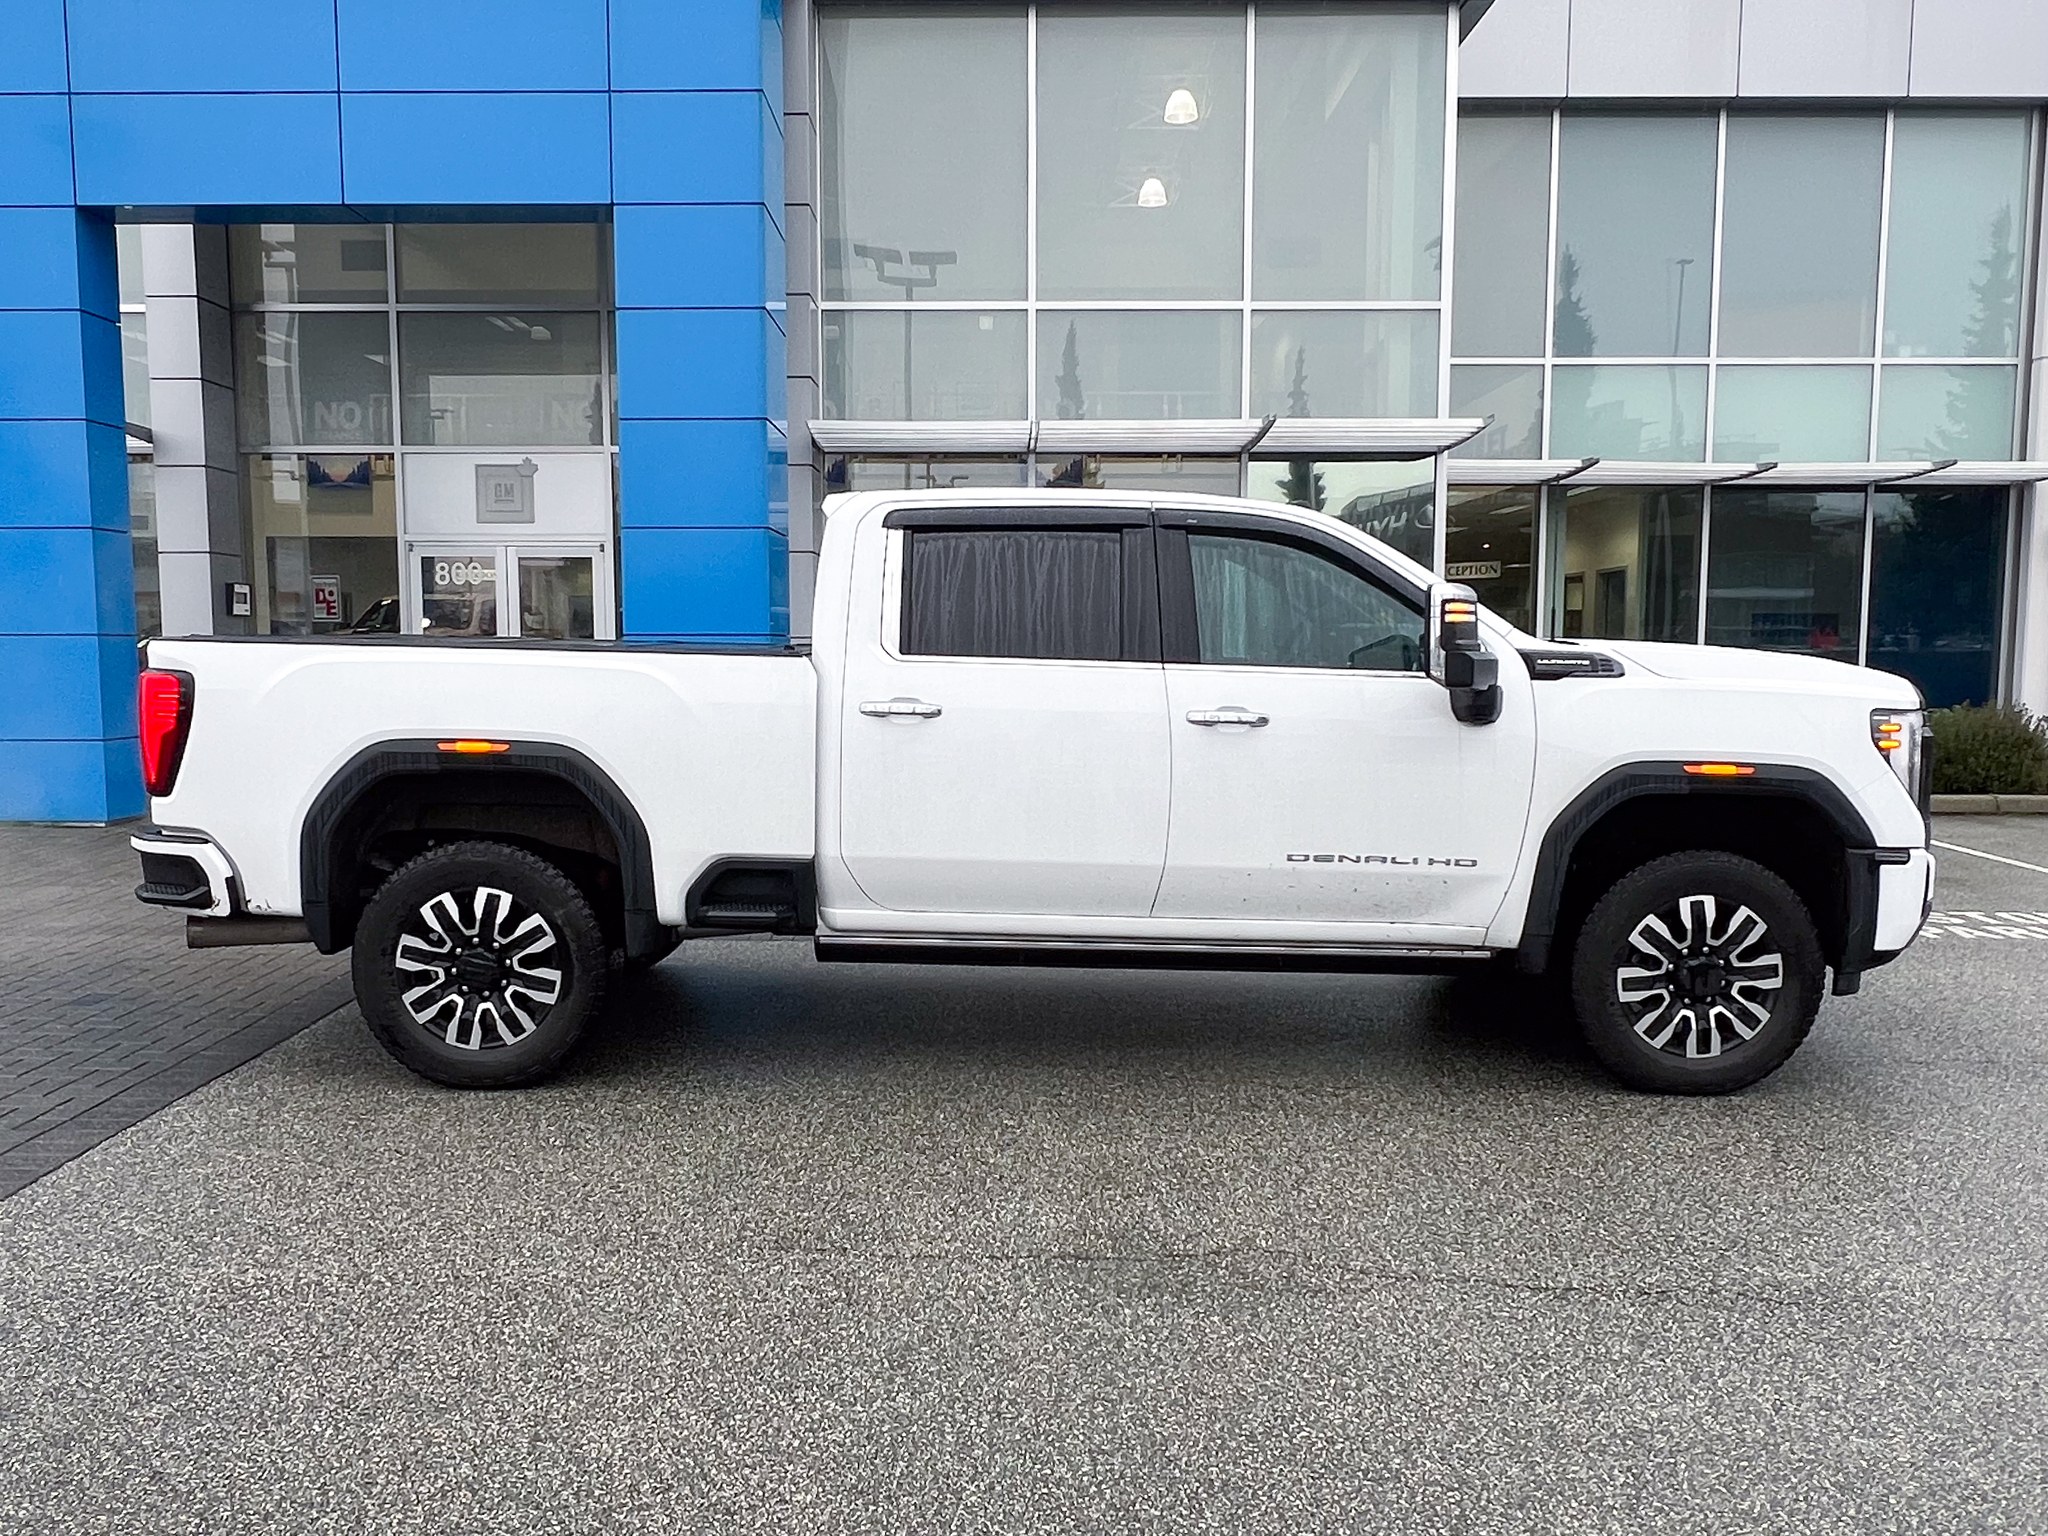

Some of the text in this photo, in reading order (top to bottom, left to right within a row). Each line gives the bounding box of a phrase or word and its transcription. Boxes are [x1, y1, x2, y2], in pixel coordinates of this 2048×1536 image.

[494, 483, 515, 498] GM
[435, 562, 482, 585] 800
[1447, 565, 1498, 576] CEPTION
[1286, 854, 1478, 867] DENALI HD
